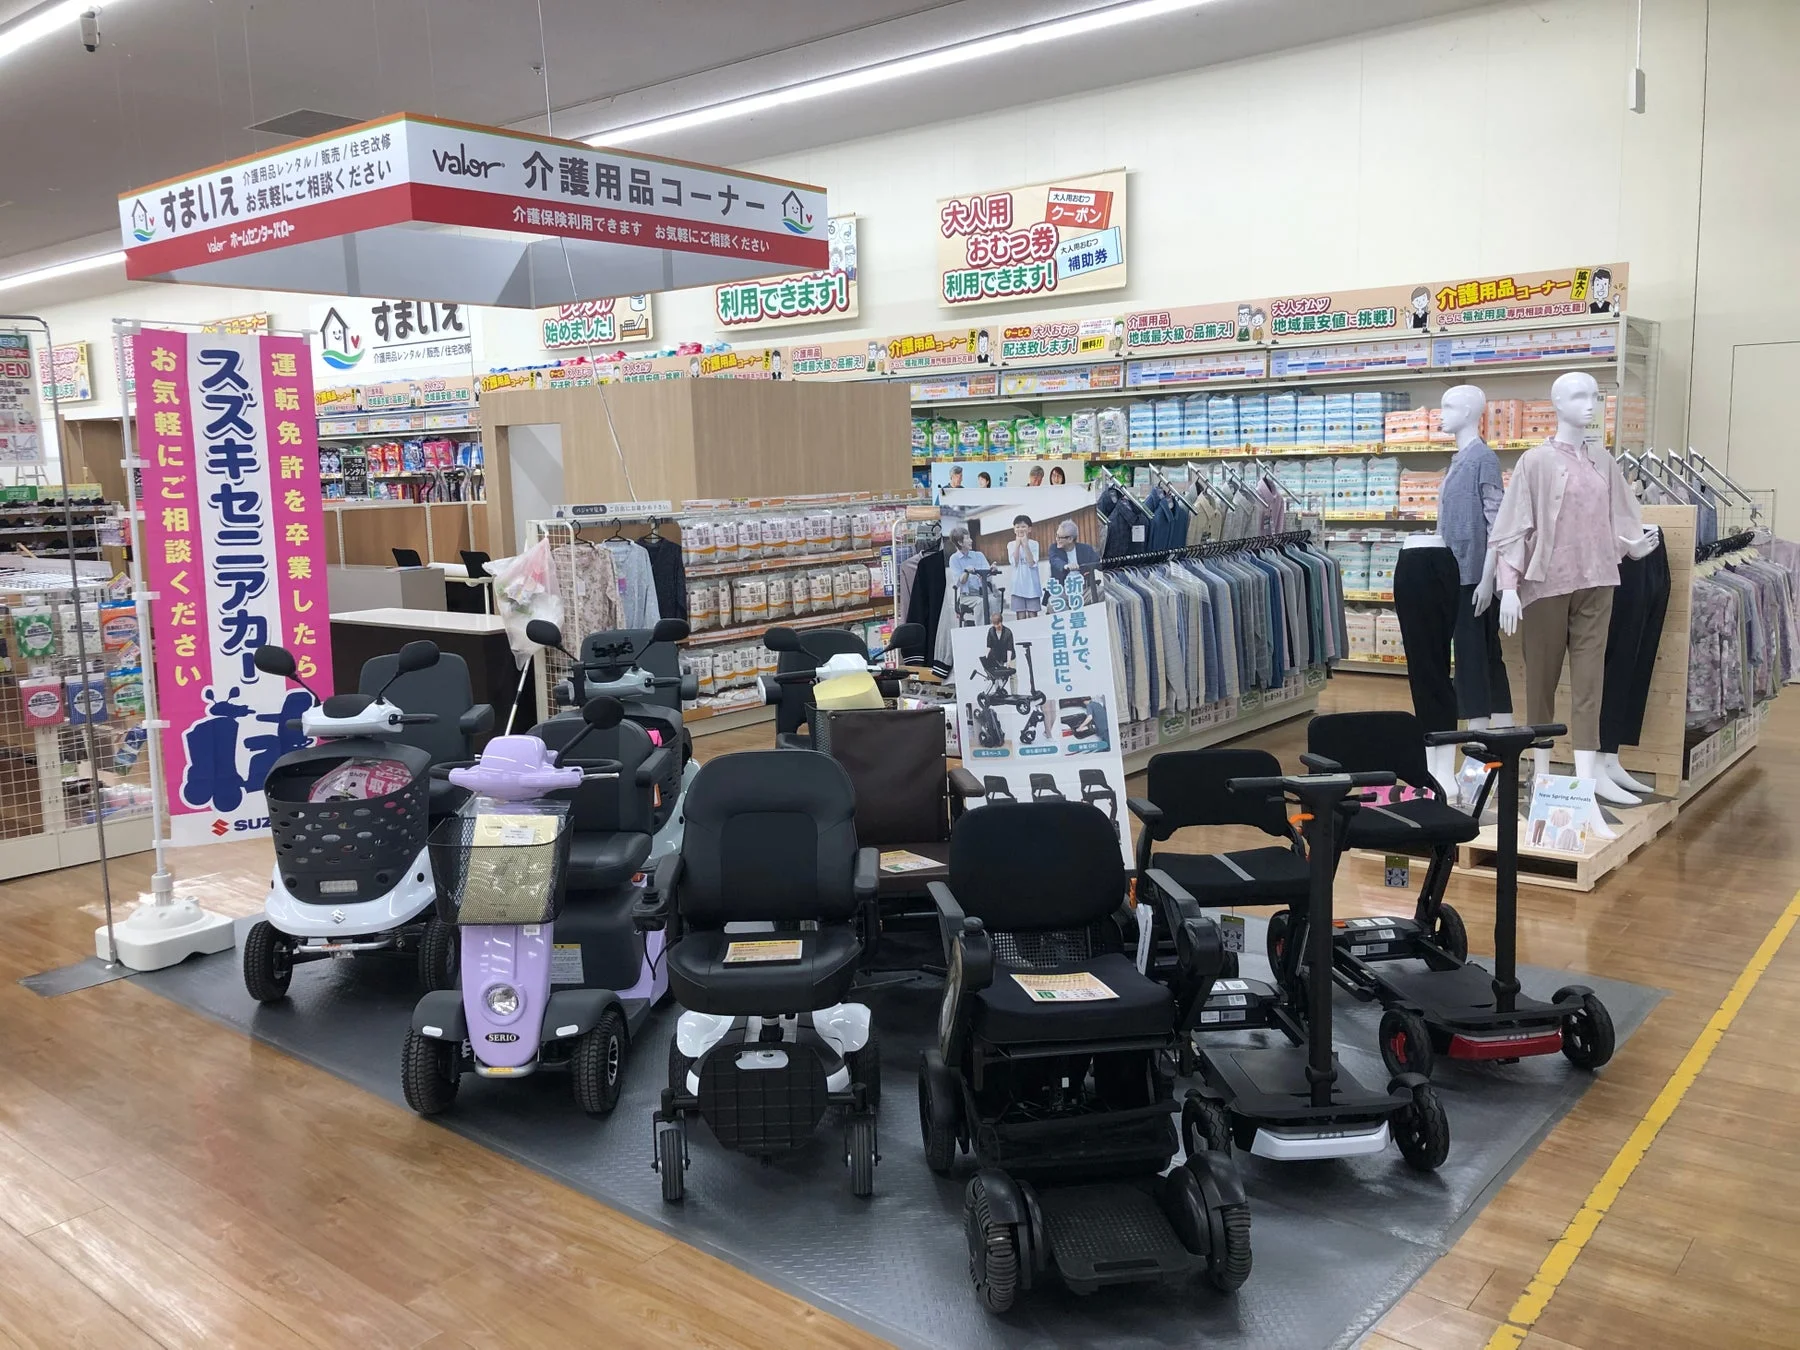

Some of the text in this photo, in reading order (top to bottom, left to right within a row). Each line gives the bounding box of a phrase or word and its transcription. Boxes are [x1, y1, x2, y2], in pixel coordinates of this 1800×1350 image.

[433, 143, 505, 179] valor
[245, 161, 392, 213] お気軽にご相談ください
[523, 150, 765, 216] 介護用品コーナー
[160, 176, 239, 232] すまいえ
[1053, 193, 1091, 203] 大人用おむつ
[943, 196, 1009, 232] 大人用
[1052, 206, 1102, 224] クーポン
[231, 220, 294, 248] ホームセンターバロー
[513, 206, 770, 252] 介護保険利用できます お気軽にご相談ください
[969, 226, 1054, 265] おむつ券
[1061, 238, 1099, 254] 大人用おむつ
[1068, 249, 1108, 271] 補助券
[947, 262, 1053, 297] 利用できます!
[720, 277, 845, 317] 利用できます!
[1272, 298, 1330, 315] 大人オムツ
[1436, 278, 1571, 310] 介護用品コーナー
[1128, 314, 1170, 328] 介護用品
[1273, 309, 1395, 333] 地域最安値に挑戦!
[1438, 302, 1585, 324] さらに福祉用具専門相談員が在籍!
[545, 316, 613, 343] 始めました!
[1034, 324, 1078, 337] 大人おむつ
[1129, 322, 1233, 345] 地域最大級の品揃え!
[888, 335, 967, 358] 介護用品コーナー
[1003, 339, 1077, 358] 配送致します!
[702, 354, 763, 373] 介護用品コーナー
[150, 346, 202, 687] お気軽にご相談ください
[199, 348, 268, 682] スズキセニアカー
[271, 353, 317, 679] 運転免許を卒業したら
[1048, 578, 1073, 692] もっと自由に。
[1066, 576, 1091, 670] 折り畳んで、
[488, 1034, 517, 1042] SERIO
